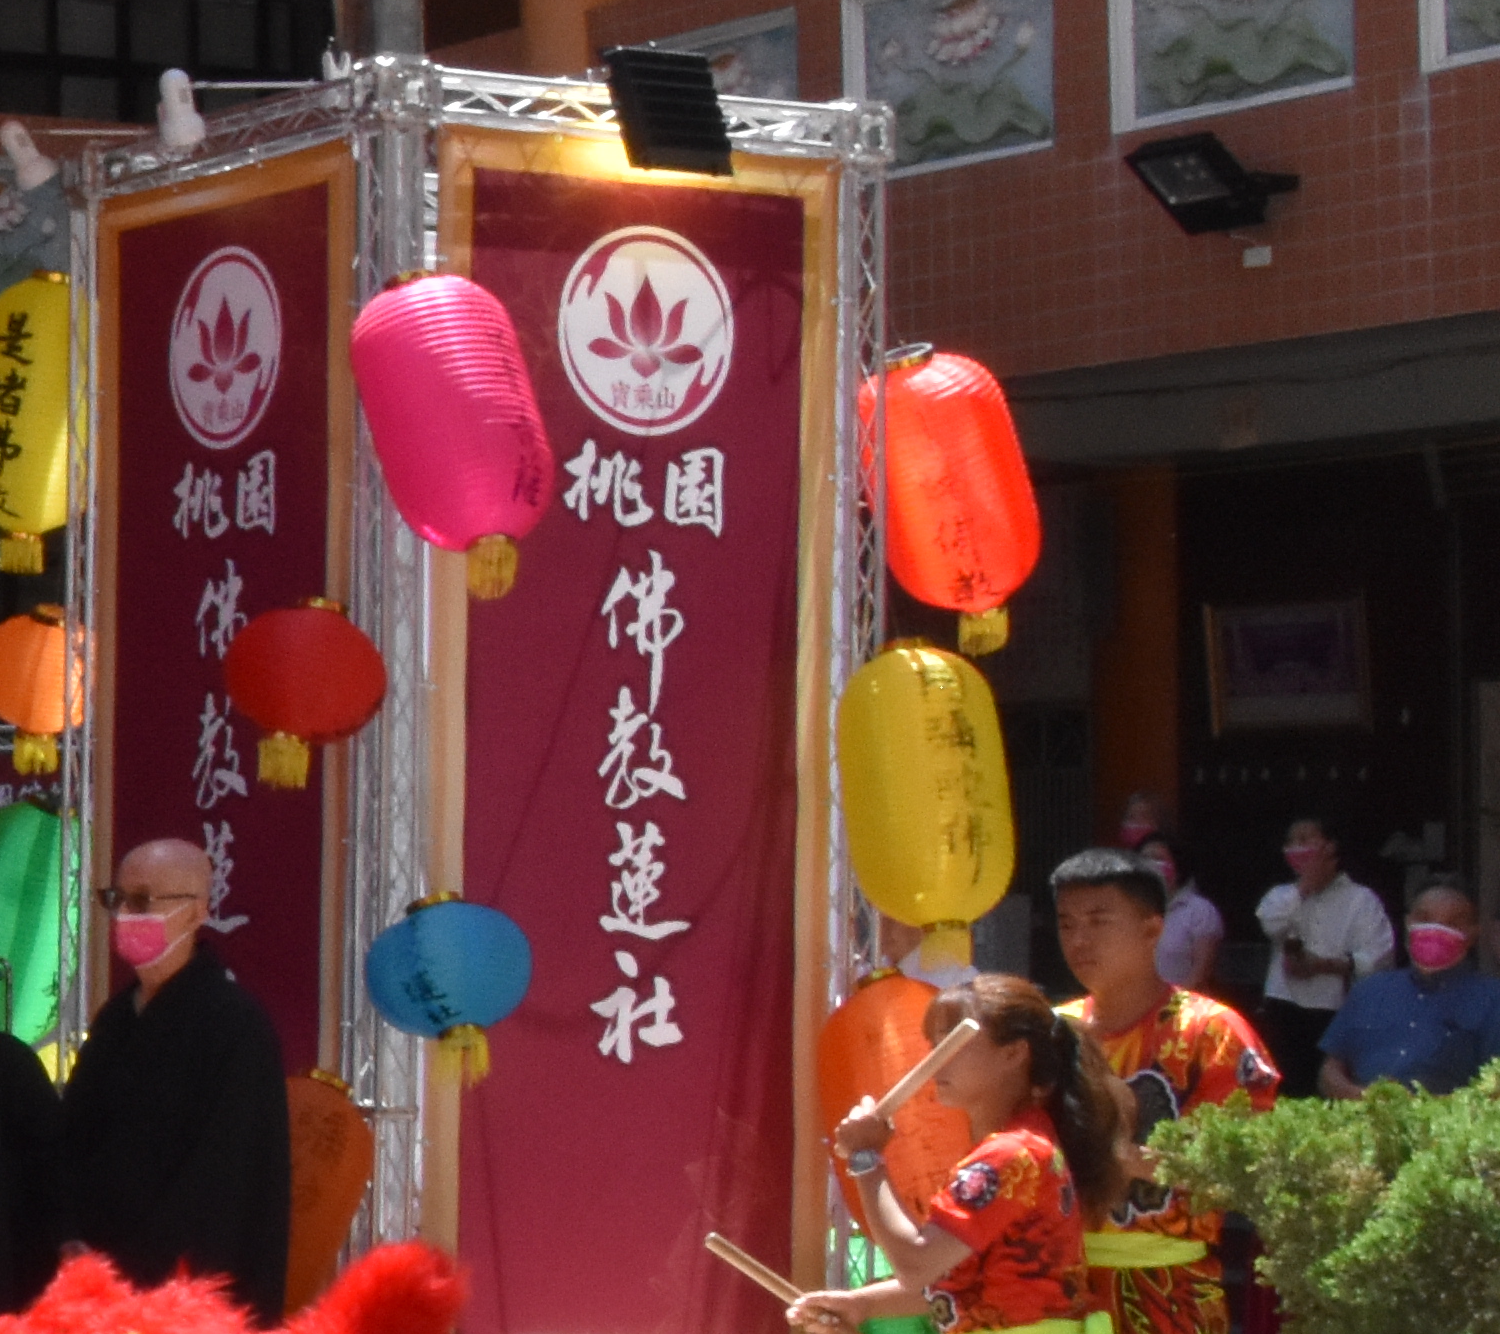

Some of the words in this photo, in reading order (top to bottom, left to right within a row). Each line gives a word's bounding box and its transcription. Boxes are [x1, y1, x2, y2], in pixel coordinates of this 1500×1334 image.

[173, 449, 278, 538] 桃園
[561, 436, 727, 539] 桃園
[589, 550, 690, 1066] 佛教蓮社
